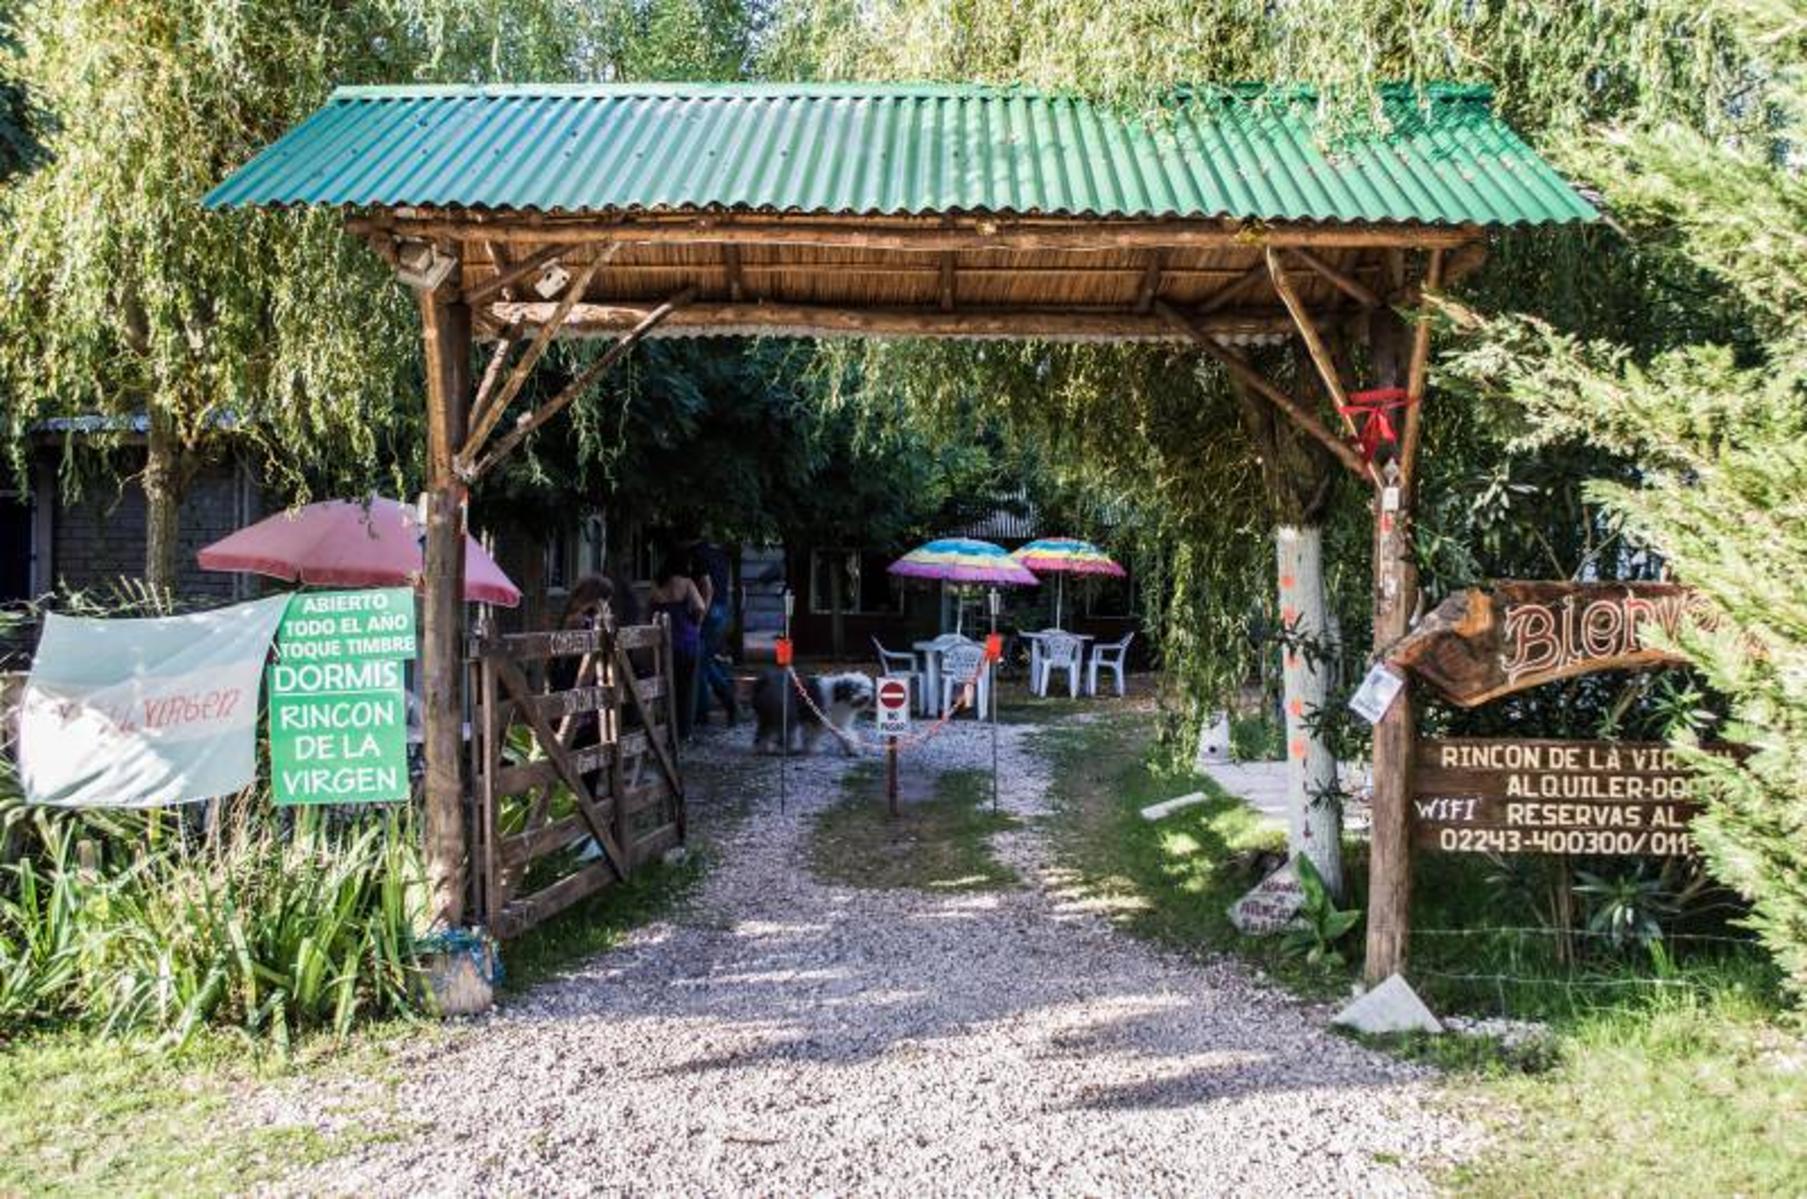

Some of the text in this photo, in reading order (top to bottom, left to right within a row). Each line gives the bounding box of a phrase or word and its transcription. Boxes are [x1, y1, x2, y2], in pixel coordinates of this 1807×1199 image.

[302, 592, 388, 614] ABIERTO
[285, 611, 408, 637] TODO EL AÑO
[280, 636, 416, 660] TOQUE TIMBRE
[274, 660, 398, 692] DORMIS
[281, 700, 394, 731] RINCON
[295, 733, 381, 760] DE LA
[1441, 745, 1540, 769] RINCON
[1550, 747, 1581, 769] DE
[1589, 748, 1622, 770] LA
[282, 766, 397, 796] VIRGEN
[1415, 798, 1475, 820] WIFI
[1507, 803, 1684, 827] RESERVAS AL
